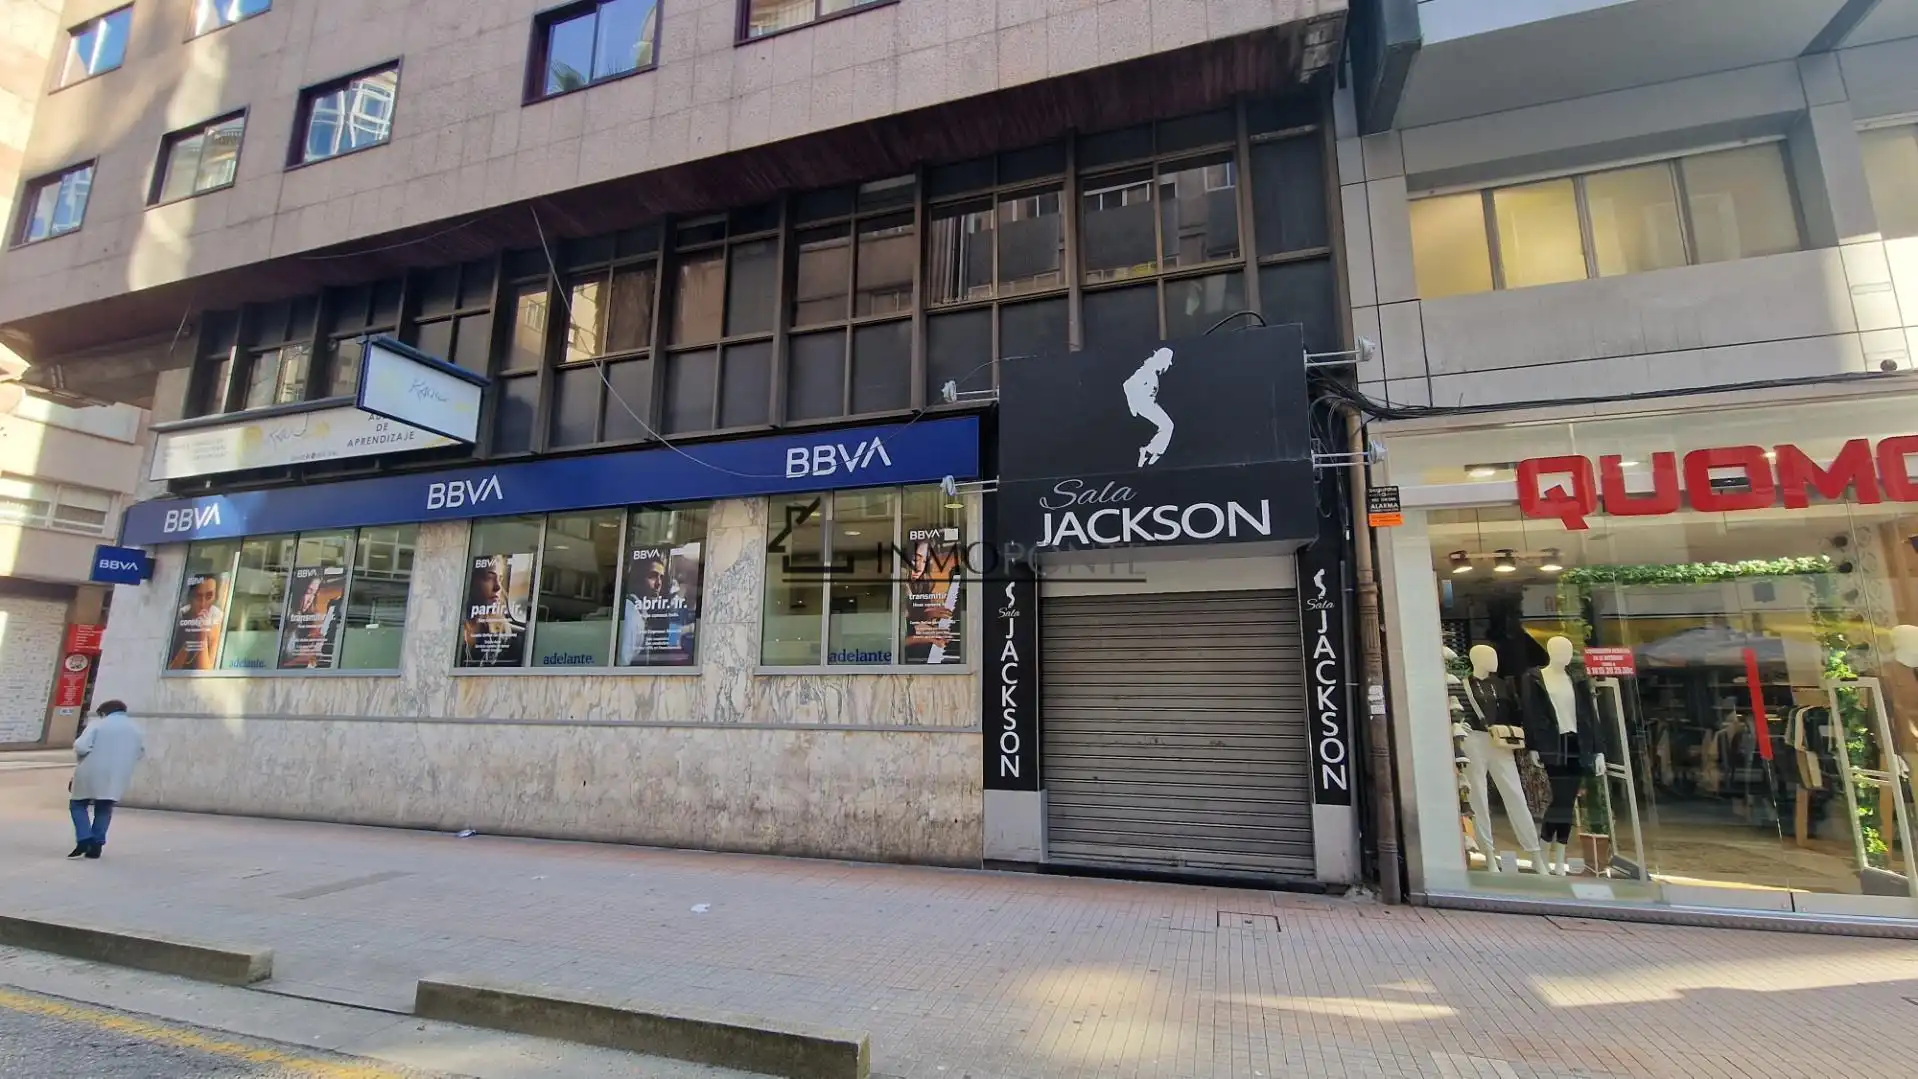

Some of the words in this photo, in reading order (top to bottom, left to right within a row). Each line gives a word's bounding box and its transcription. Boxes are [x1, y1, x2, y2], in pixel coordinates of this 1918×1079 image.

[376, 423, 388, 432] DE
[347, 431, 415, 447] APRENDIZAJE
[786, 436, 892, 479] BBVA
[426, 474, 504, 510] BBVA
[1039, 478, 1138, 510] Sala
[163, 502, 222, 533] BBVA
[1036, 499, 1272, 547] JACKSON
[909, 529, 941, 540] BBVA
[633, 549, 660, 560] BBVA
[99, 558, 140, 571] BBVA
[297, 568, 317, 578] BBVA
[471, 602, 507, 618] partir.
[634, 595, 671, 610] abrir.
[1306, 598, 1335, 610] Sala
[999, 606, 1020, 618] Sala
[543, 652, 595, 665] adelante.
[1000, 618, 1020, 778] JACKSON
[1313, 610, 1347, 790] JACKSON
